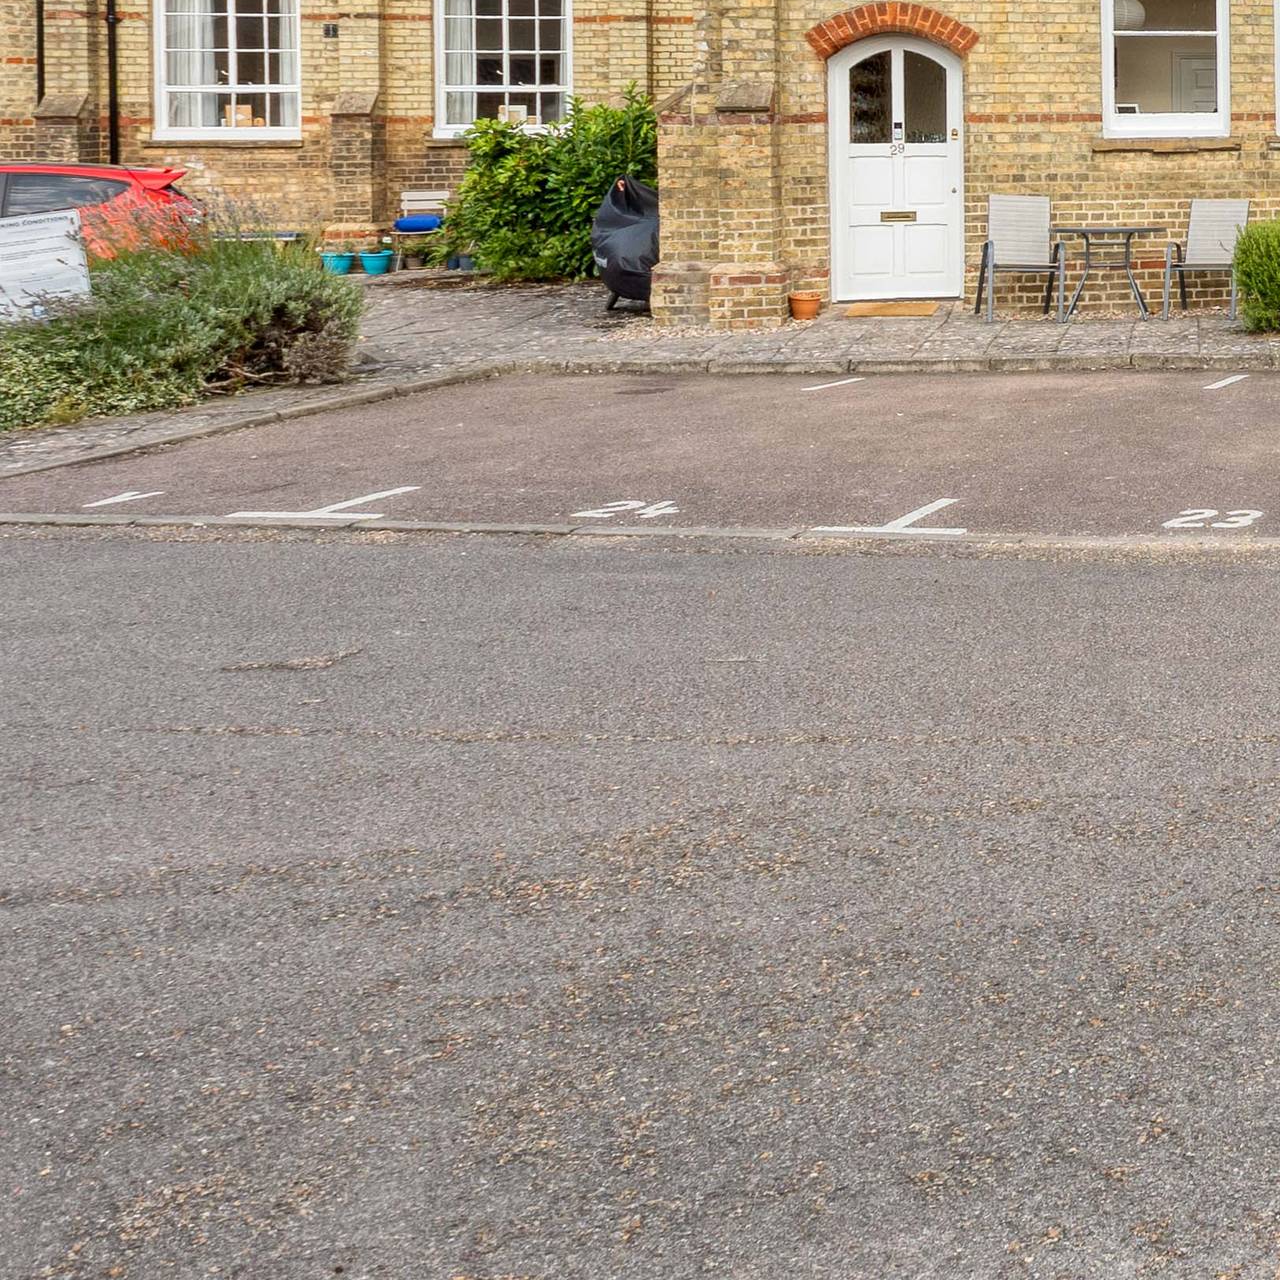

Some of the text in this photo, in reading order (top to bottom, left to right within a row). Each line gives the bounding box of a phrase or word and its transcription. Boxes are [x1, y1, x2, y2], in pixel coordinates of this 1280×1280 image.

[889, 143, 905, 156] 29
[569, 500, 680, 518] 24
[1161, 508, 1264, 528] 23
